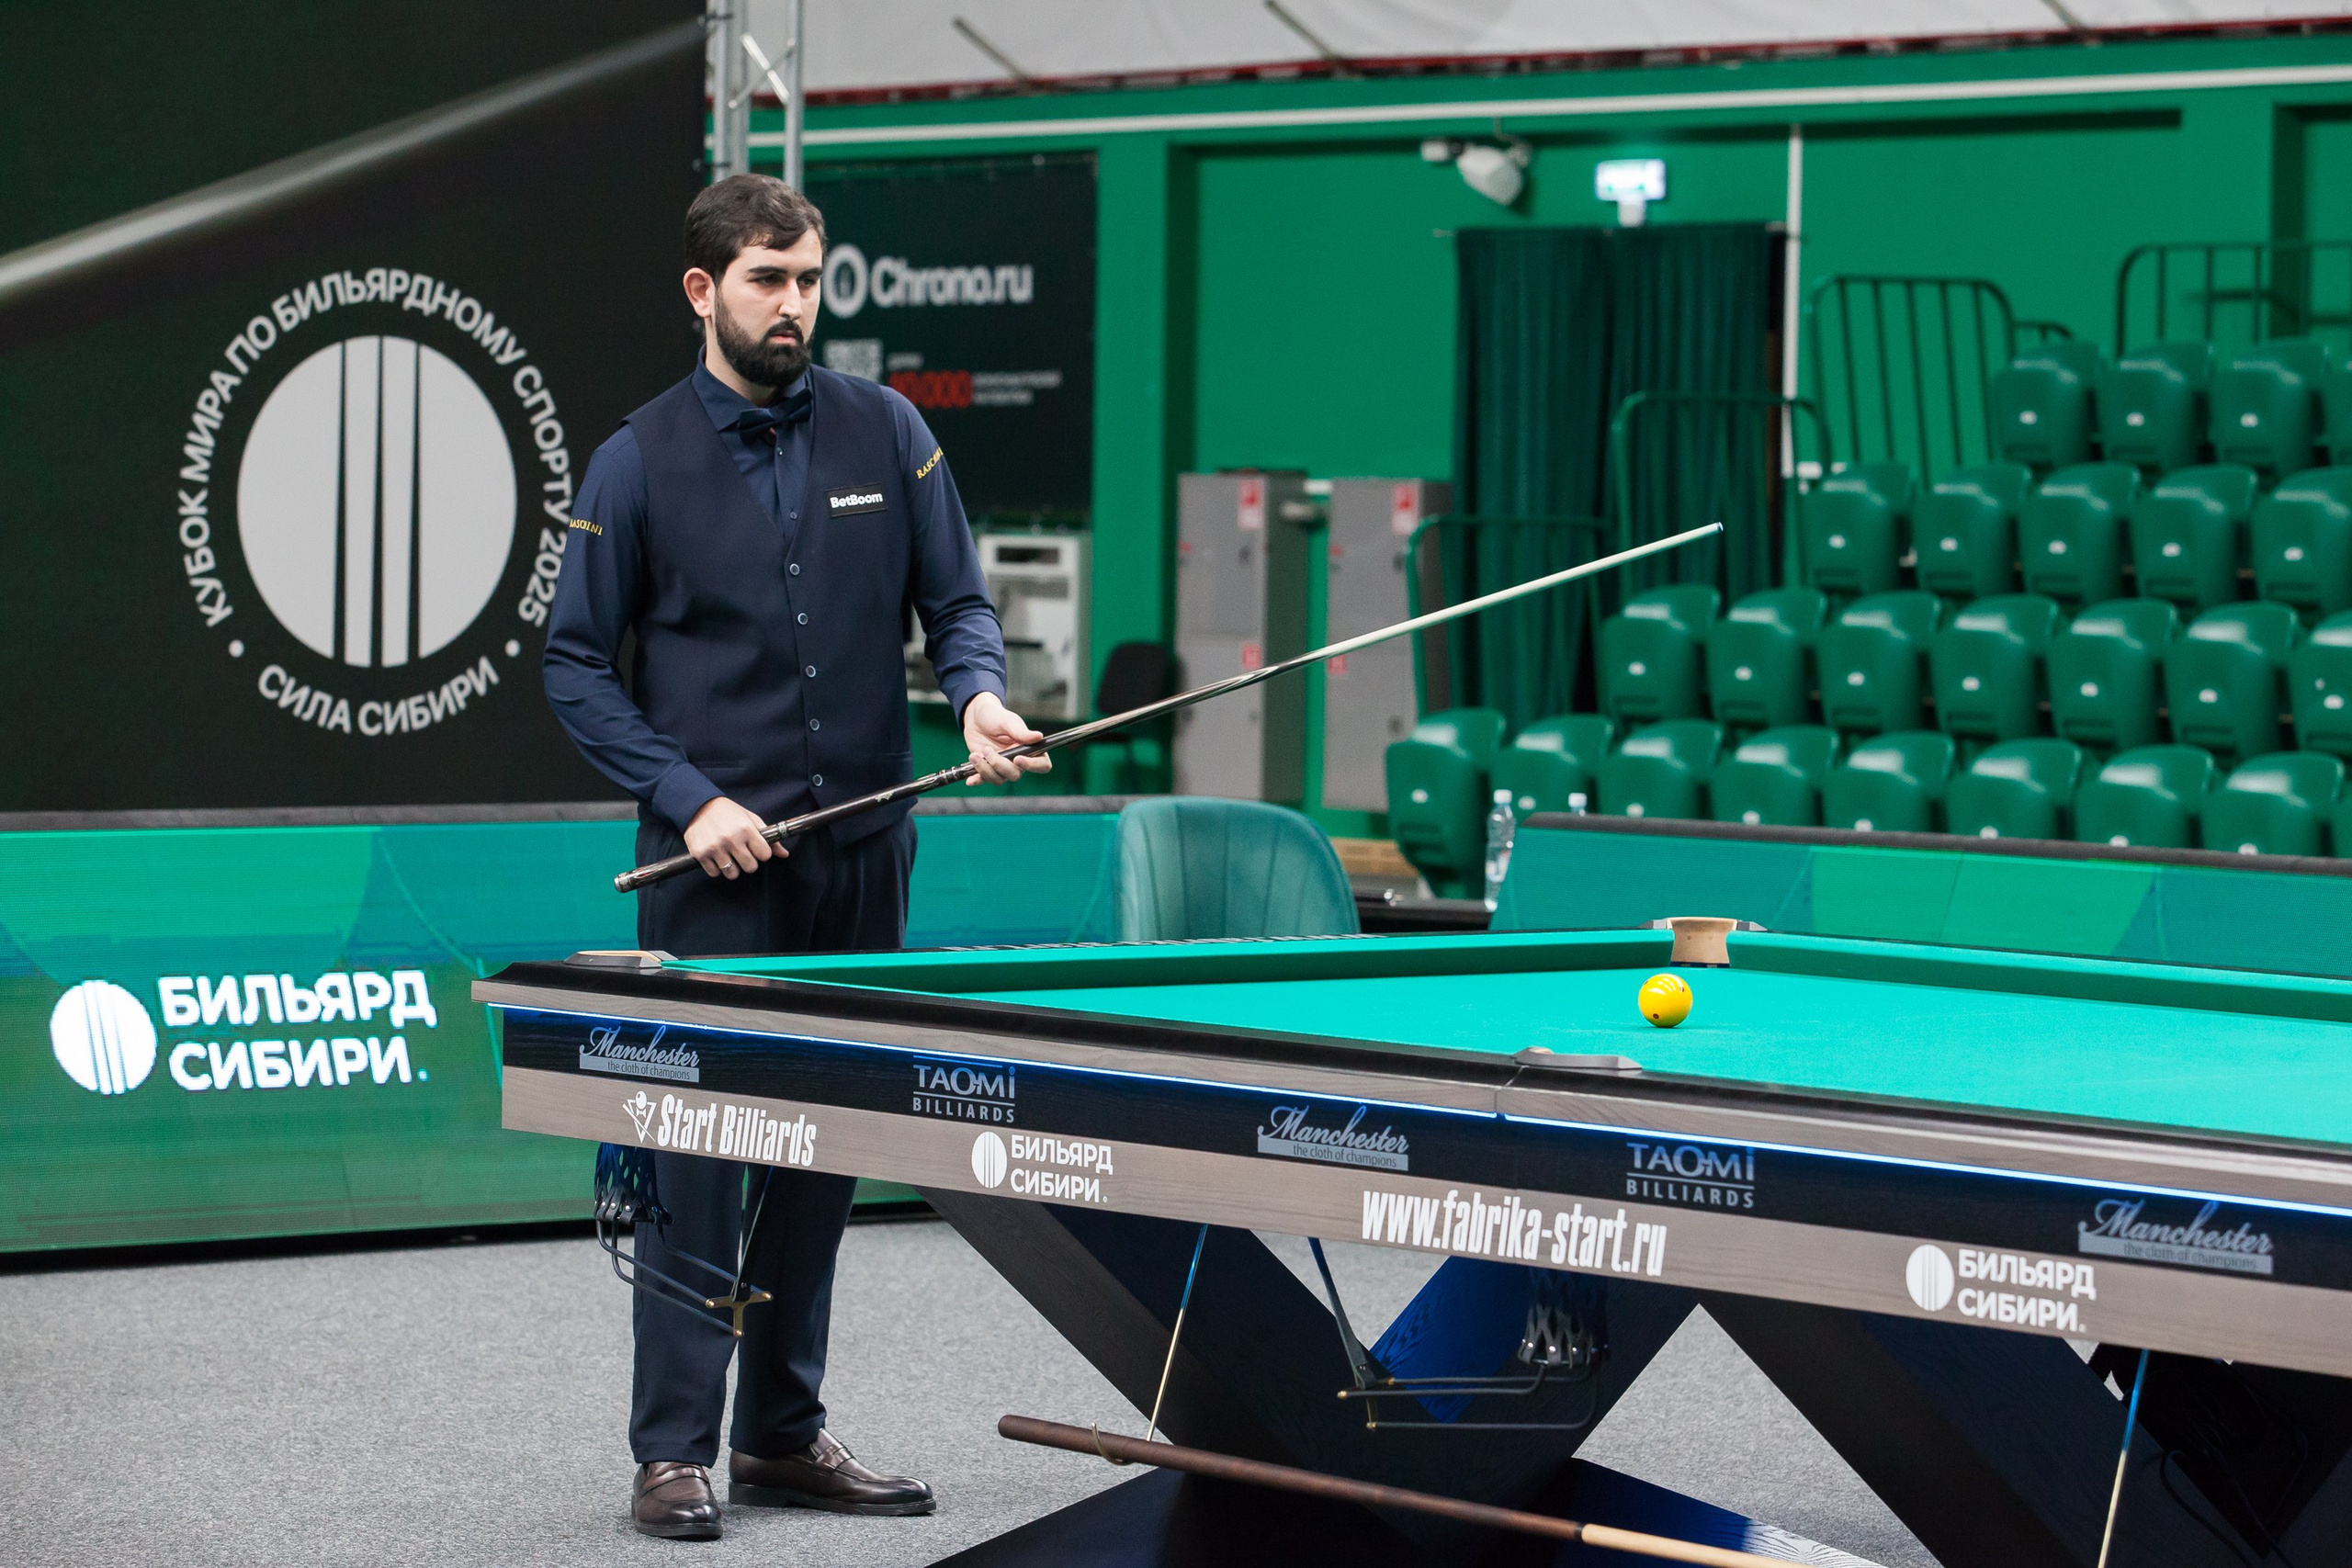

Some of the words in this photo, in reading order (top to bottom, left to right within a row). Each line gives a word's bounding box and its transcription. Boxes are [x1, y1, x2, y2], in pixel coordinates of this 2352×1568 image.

[224, 315, 277, 375] ПО
[271, 267, 527, 366] БИЛЬЯРДНОМУ
[179, 370, 242, 483] МИРА
[512, 365, 571, 525] СПОРТУ
[830, 492, 884, 508] BetBoom
[177, 489, 233, 627] КУБОК
[517, 527, 568, 628] 2025
[257, 664, 353, 734] СИЛА
[356, 656, 499, 737] СИБИРИ
[159, 970, 437, 1028] БИЛЬЯРД
[579, 1025, 700, 1067] Manchester
[607, 1061, 620, 1072] the
[621, 1062, 639, 1074] cloth
[641, 1065, 650, 1075] of
[650, 1066, 690, 1079] champions
[657, 1093, 717, 1153] Start
[718, 1104, 817, 1167] Billiards
[912, 1097, 1015, 1123] BILLIARDS
[1257, 1105, 1409, 1154] Manchester
[1012, 1134, 1114, 1175] БИЛЬЯРД
[1293, 1144, 1308, 1156] the
[1310, 1145, 1332, 1159] cloth
[1335, 1149, 1344, 1161] of
[1346, 1151, 1396, 1168] champions
[1626, 1179, 1754, 1209] BILLIARDS
[1362, 1189, 1668, 1277] www.fabrika-start.ru
[2077, 1198, 2274, 1254] Manchester
[1958, 1248, 2098, 1301] БИЛЬЯРД
